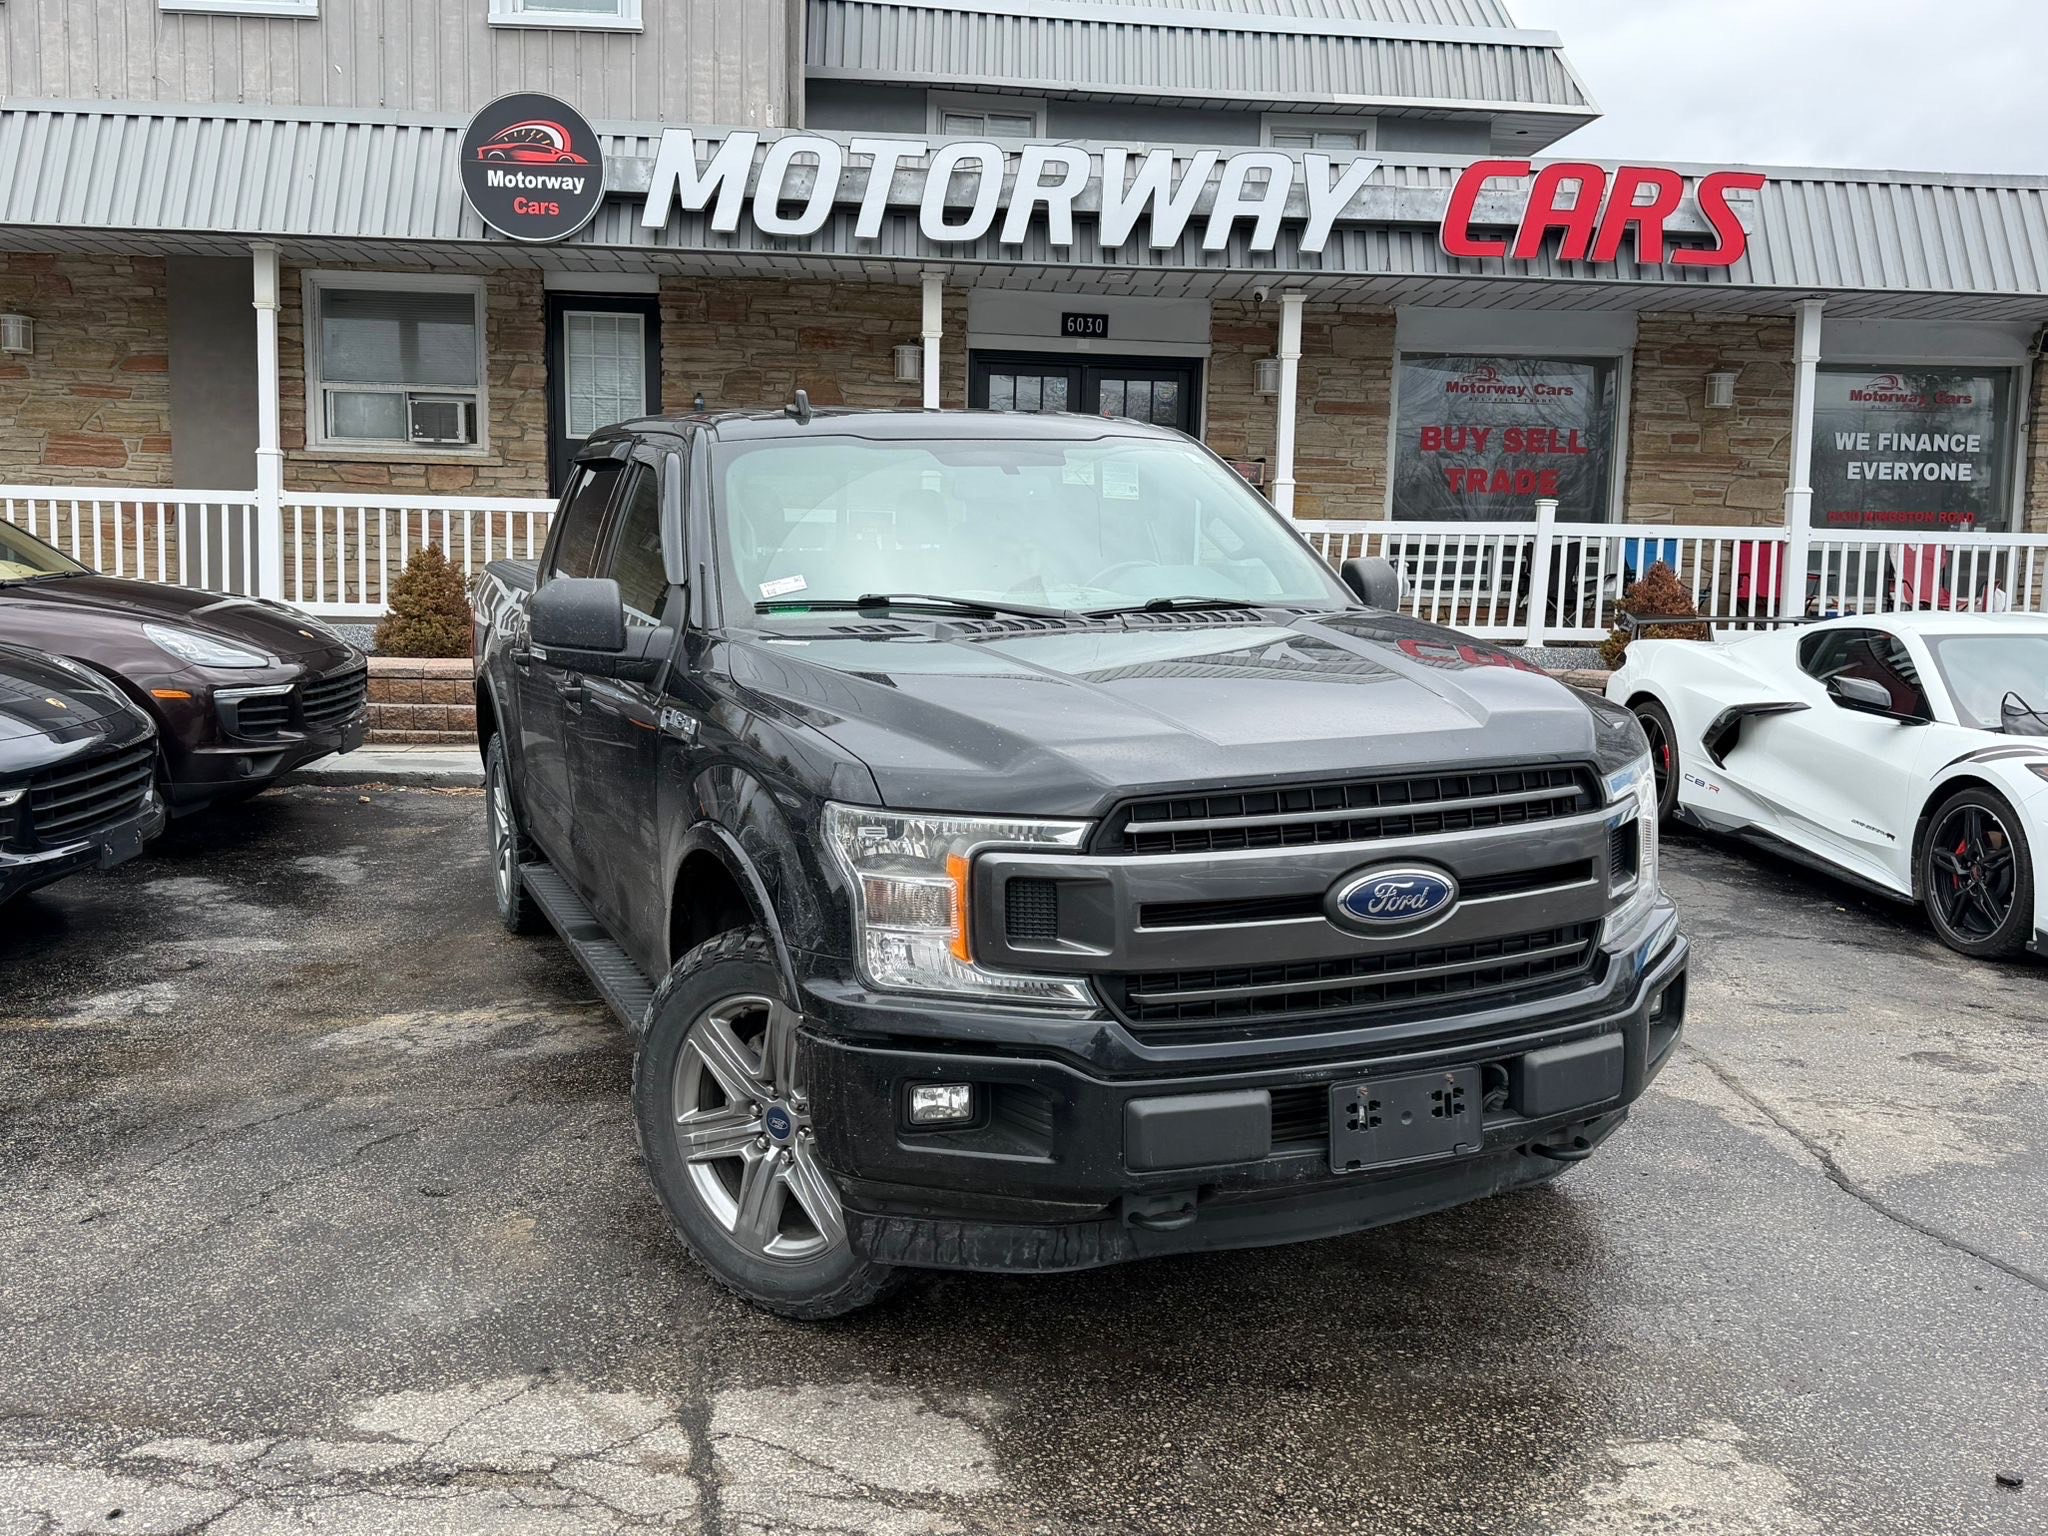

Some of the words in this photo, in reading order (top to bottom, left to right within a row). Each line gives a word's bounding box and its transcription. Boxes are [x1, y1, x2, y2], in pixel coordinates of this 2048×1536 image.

[486, 169, 585, 194] Motorway
[641, 128, 1382, 253] MOTORWAY
[513, 197, 561, 216] Cars
[1440, 159, 1767, 266] CARS
[1067, 317, 1103, 333] 6030
[1445, 381, 1526, 397] Motorway
[1535, 383, 1574, 396] Cars
[1849, 389, 1928, 407] Motorway
[1420, 426, 1492, 453] BUY
[1504, 427, 1589, 455] SELL
[1835, 432, 1870, 451] WE
[1878, 433, 1981, 452] FINANCE
[1444, 467, 1560, 496] TRADE
[1847, 462, 1972, 481] EVERYONE
[1368, 881, 1430, 914] Ford
